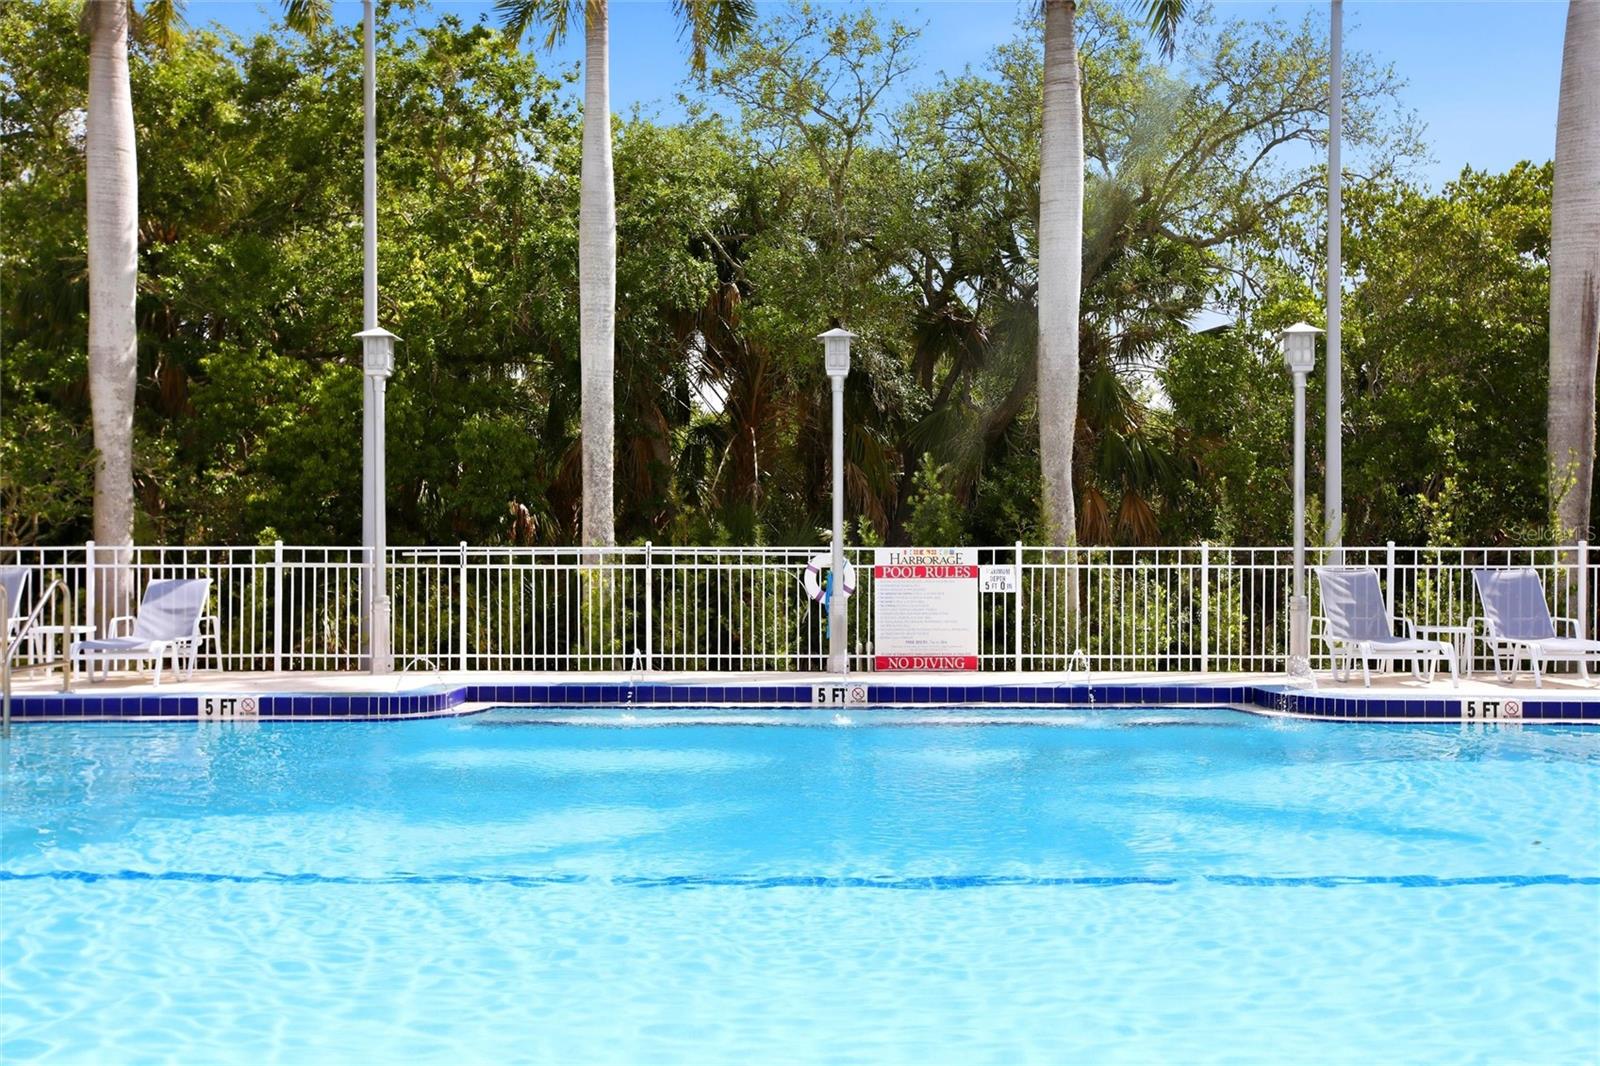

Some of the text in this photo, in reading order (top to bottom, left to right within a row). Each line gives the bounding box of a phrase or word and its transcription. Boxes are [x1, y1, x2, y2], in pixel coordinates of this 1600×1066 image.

[883, 566, 971, 578] POOL RULES
[985, 581, 990, 590] 5
[888, 657, 965, 669] NO DIVING
[818, 687, 848, 703] 5 FT
[205, 698, 237, 715] 5 FT
[1467, 701, 1500, 718] 5 FT
